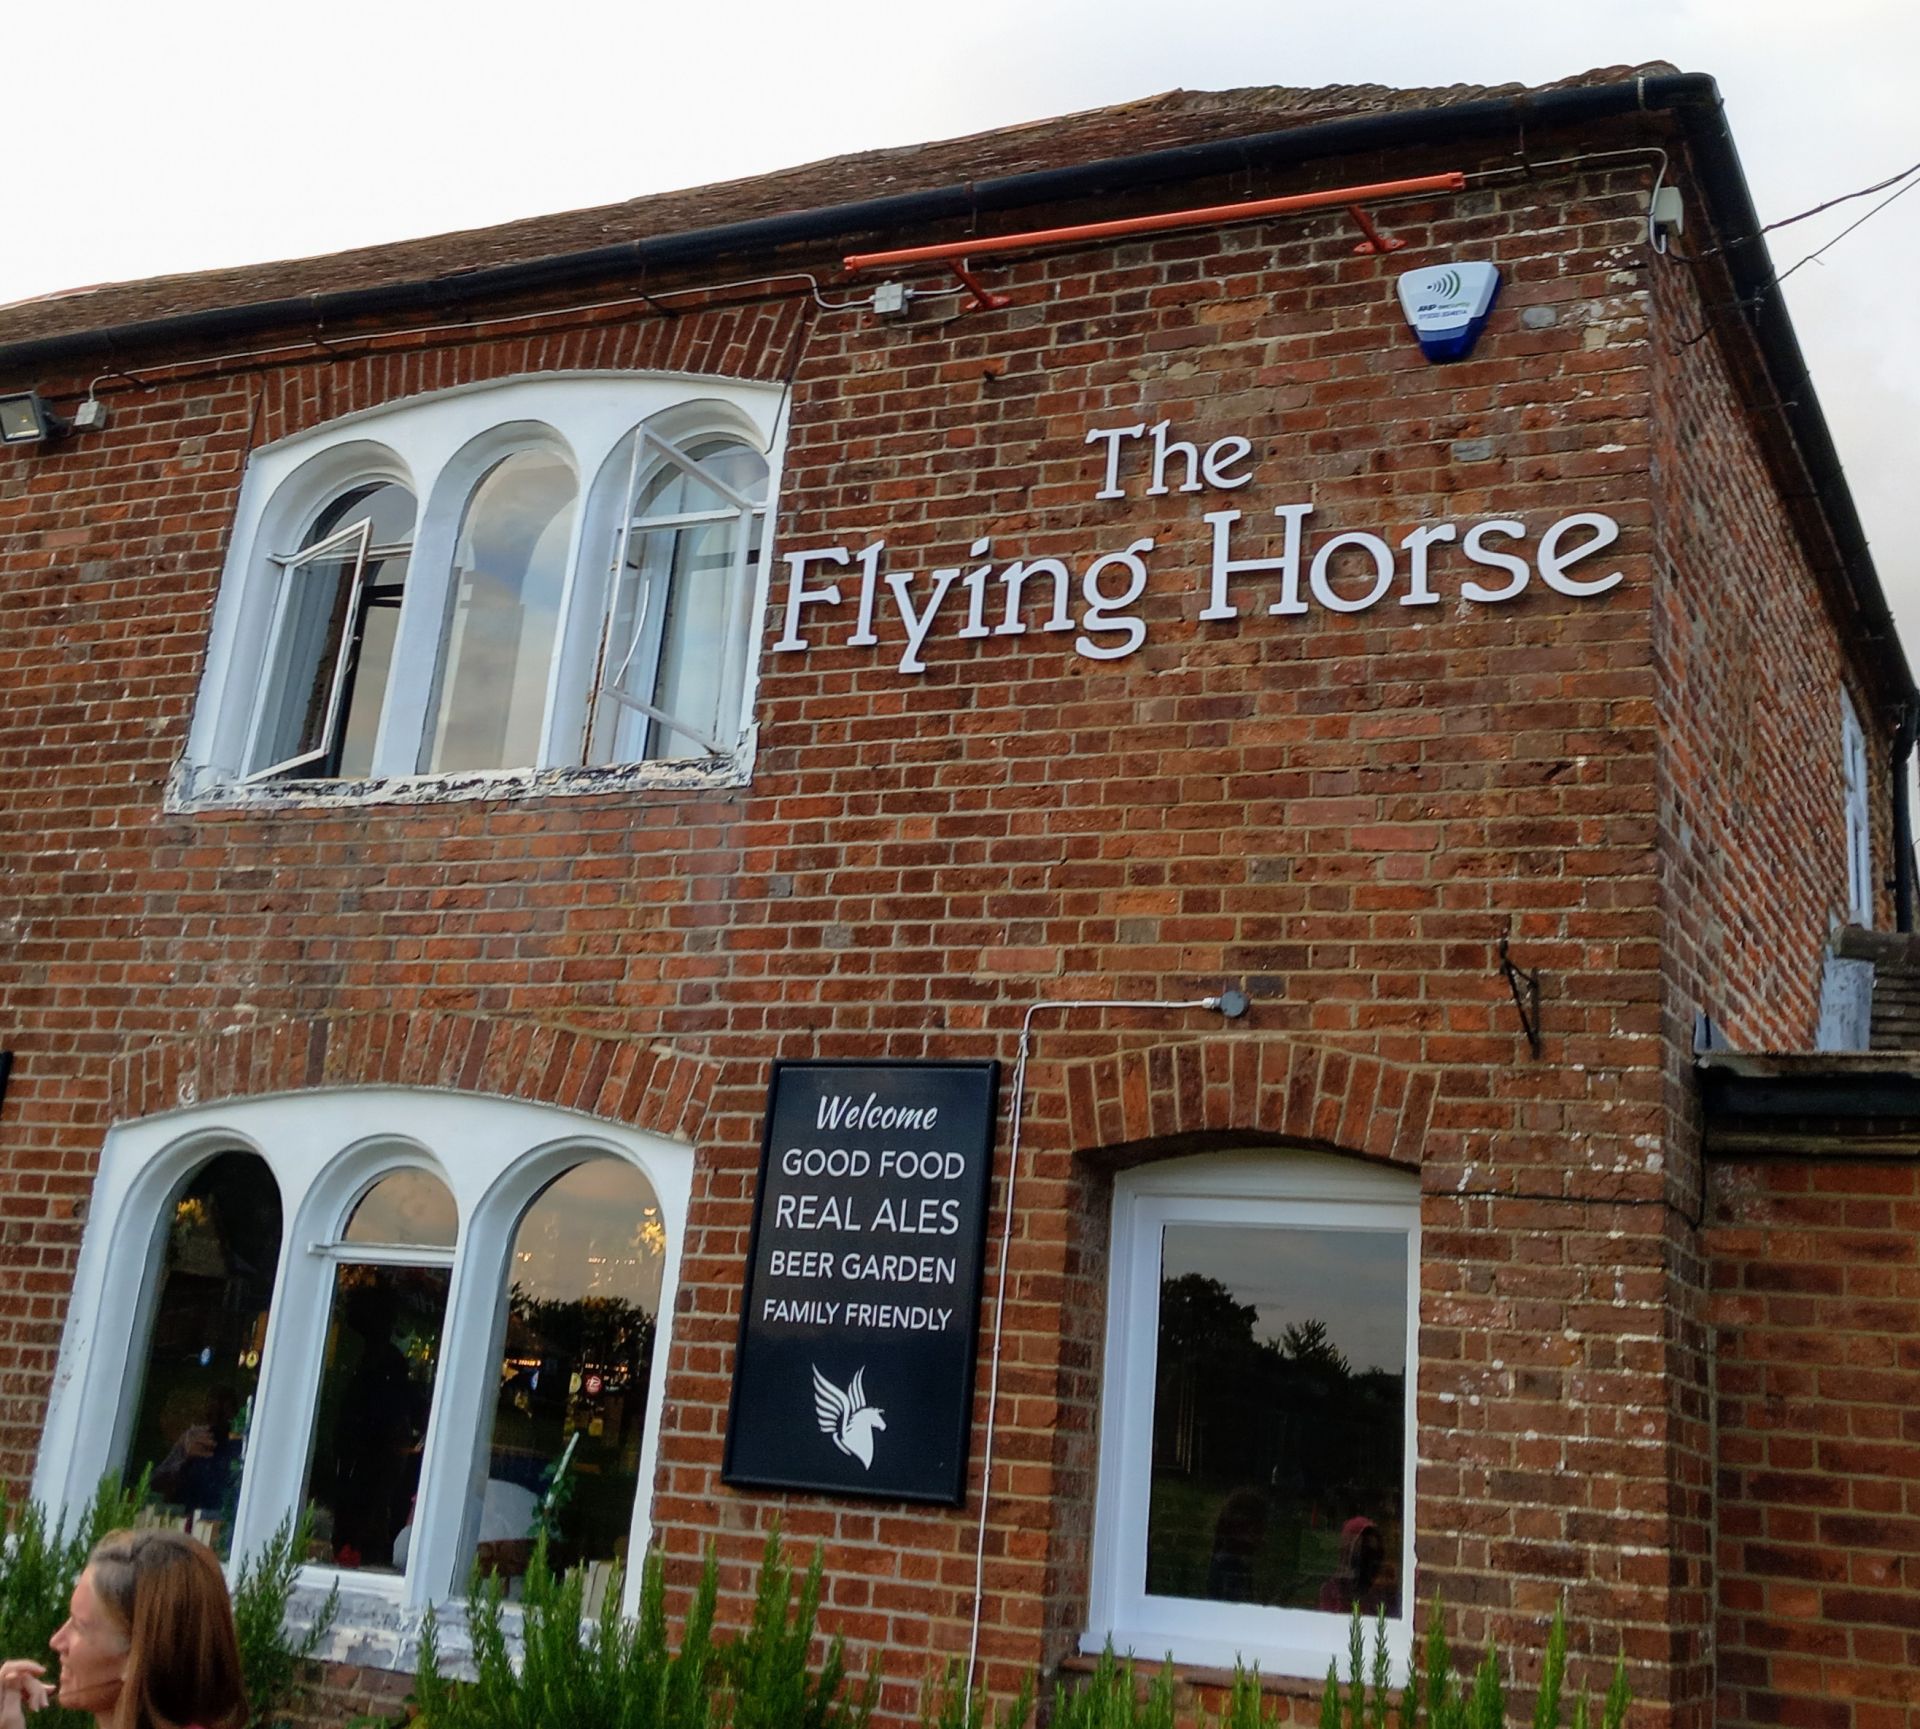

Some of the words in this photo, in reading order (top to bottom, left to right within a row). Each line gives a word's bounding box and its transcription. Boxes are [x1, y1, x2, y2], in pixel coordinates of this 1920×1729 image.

[1086, 419, 1253, 500] The
[772, 536, 1156, 675] Flying
[1200, 503, 1625, 622] Horse
[816, 1092, 938, 1130] Welcome
[782, 1148, 871, 1177] GOOD
[879, 1150, 966, 1180] FOOD
[775, 1194, 861, 1232] REAL
[870, 1197, 961, 1236] ALES
[769, 1250, 834, 1279] BEER
[841, 1252, 956, 1285] GARDEN
[763, 1299, 840, 1325] FAMILY
[845, 1303, 953, 1332] FRIENDLY
